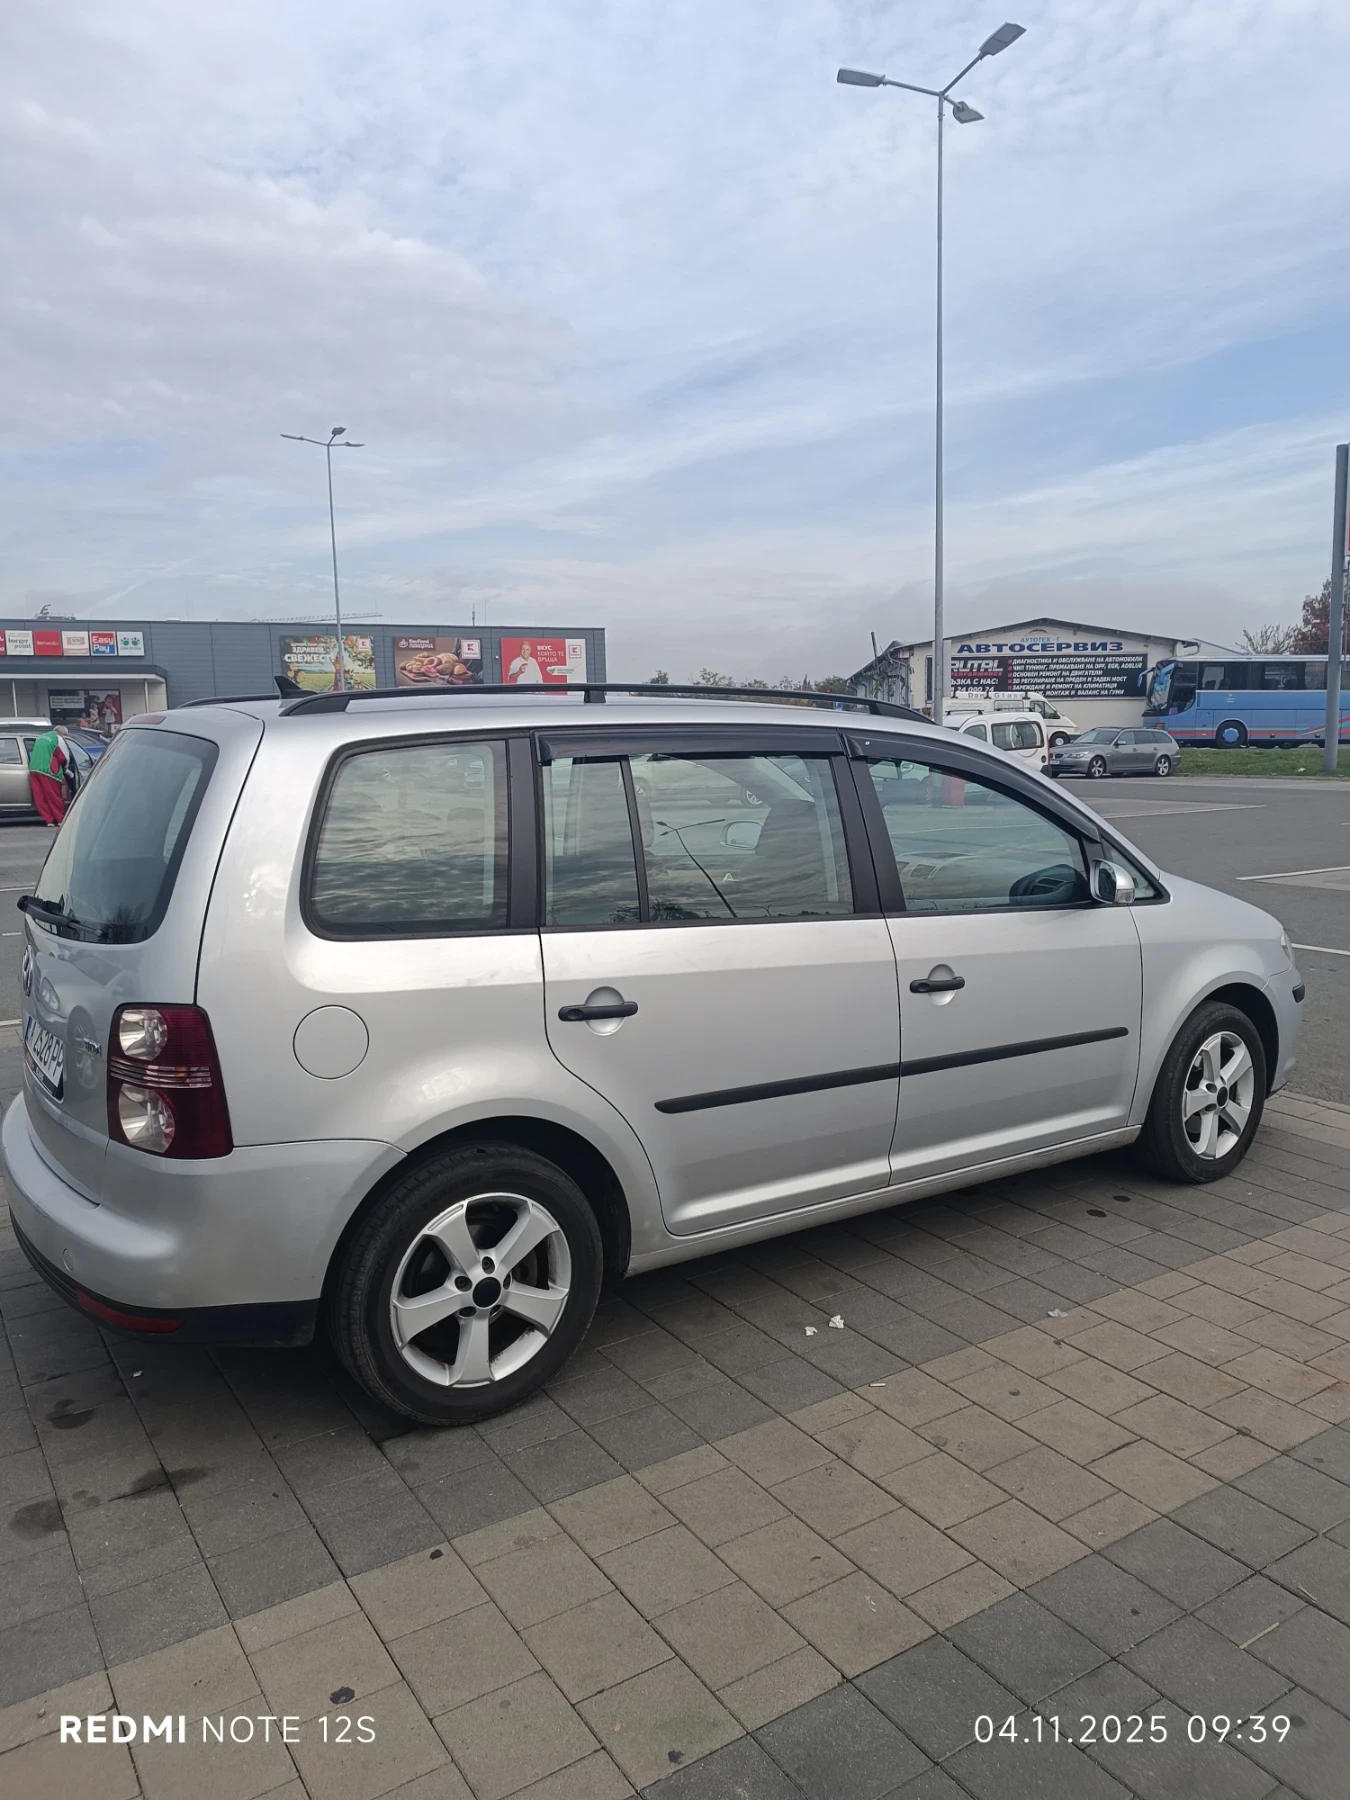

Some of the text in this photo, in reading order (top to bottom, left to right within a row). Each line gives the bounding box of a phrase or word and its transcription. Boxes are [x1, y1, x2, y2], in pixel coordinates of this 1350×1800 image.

[93, 636, 114, 645] Easy
[94, 644, 110, 653] Pay
[957, 642, 1124, 654] АВТОСЕРВИЗ
[951, 660, 1003, 672] RUTAL
